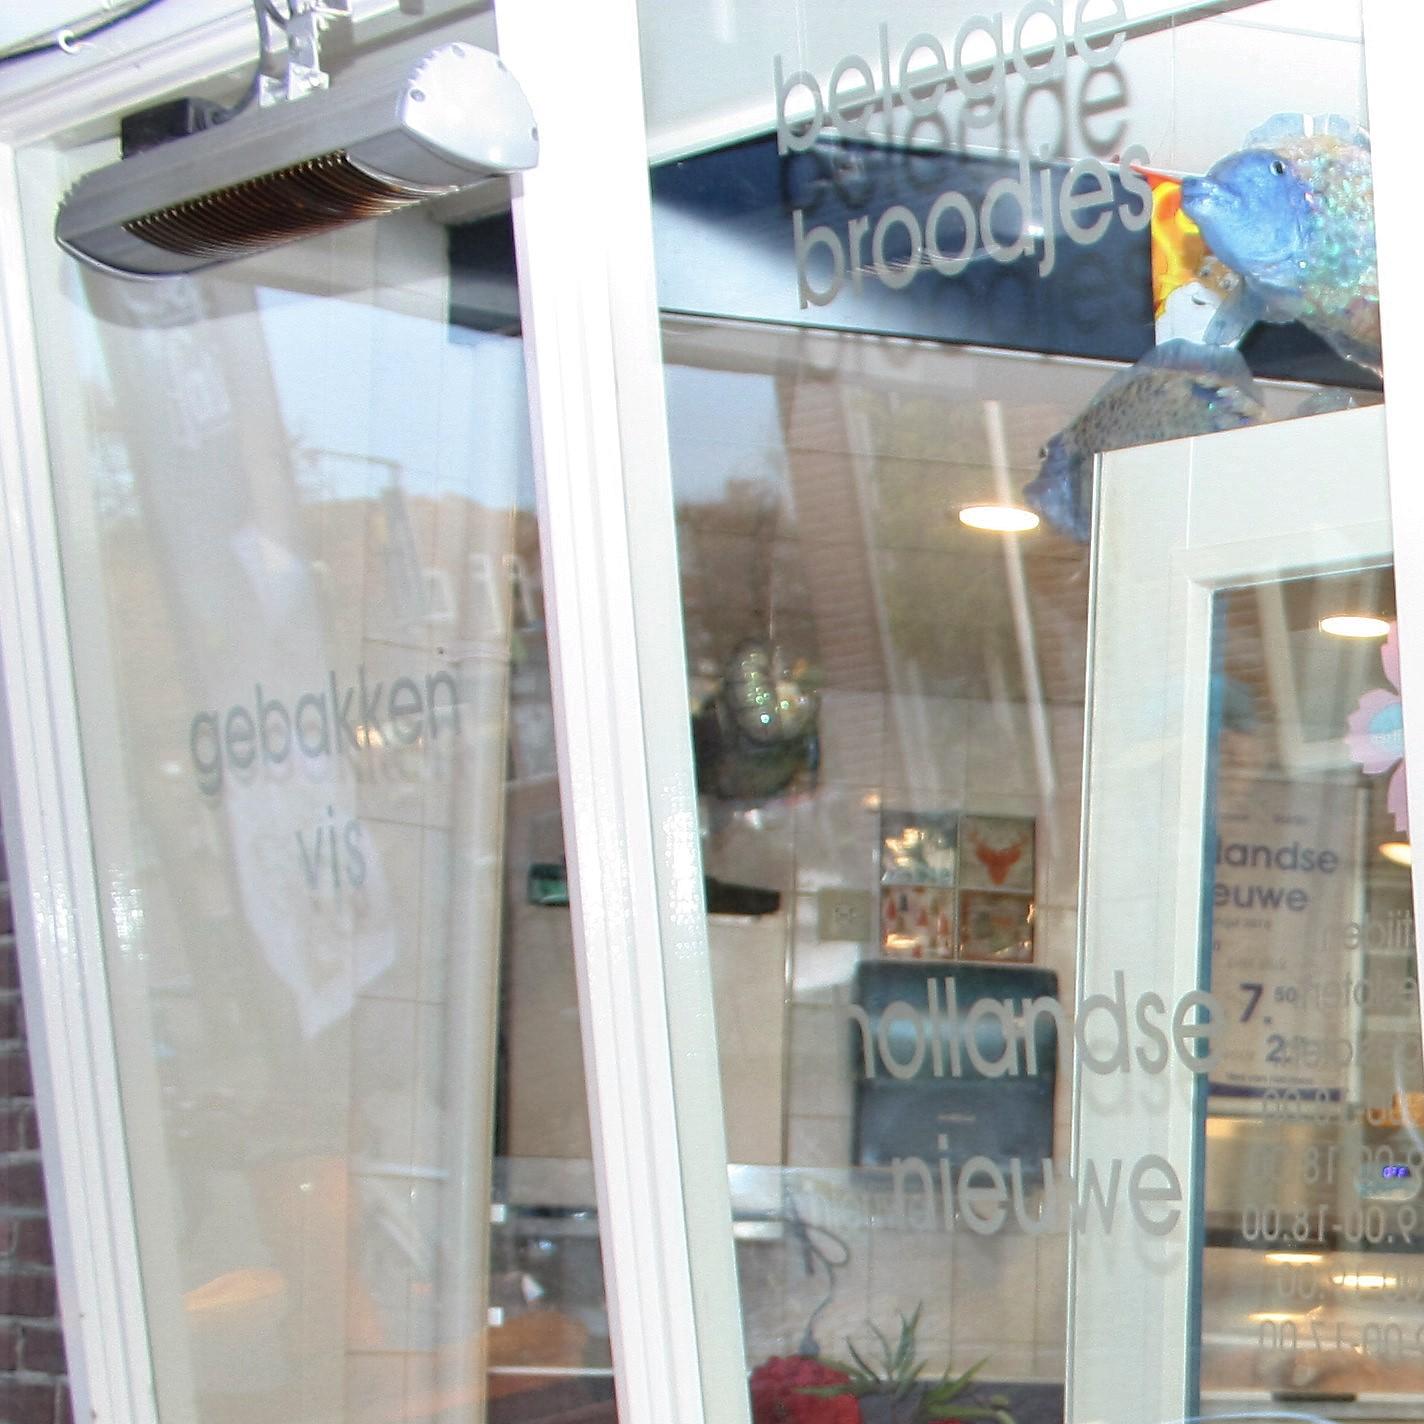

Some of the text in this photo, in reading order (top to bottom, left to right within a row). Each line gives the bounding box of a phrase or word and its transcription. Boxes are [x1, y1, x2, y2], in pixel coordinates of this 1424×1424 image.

[773, 0, 1128, 156] belegde
[793, 143, 1154, 310] broodjes
[189, 662, 463, 797] gebakken
[295, 804, 367, 891] vis
[831, 970, 1226, 1080] hollandse
[891, 1133, 1183, 1237] nieuwe
